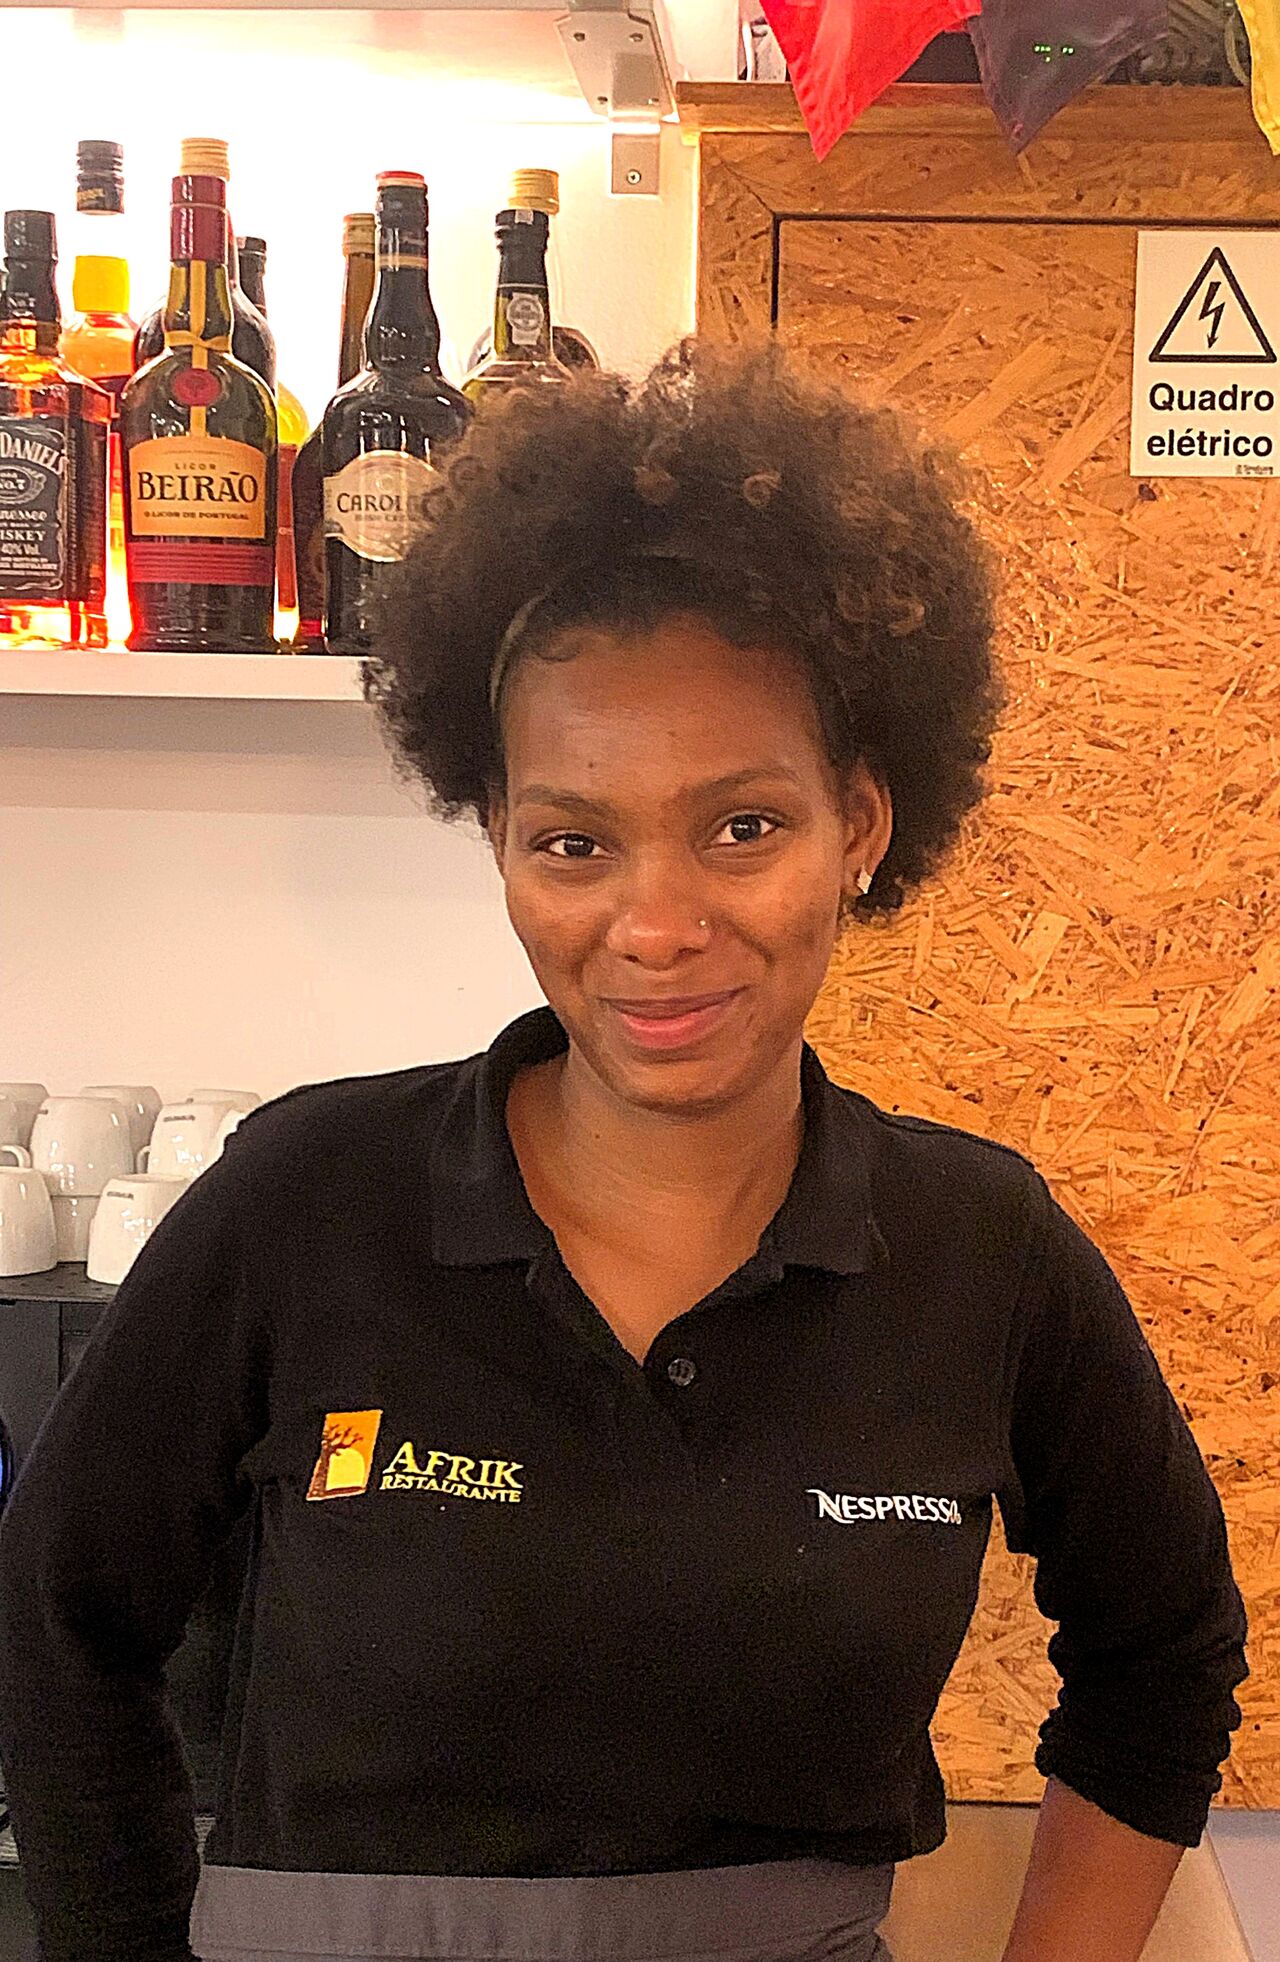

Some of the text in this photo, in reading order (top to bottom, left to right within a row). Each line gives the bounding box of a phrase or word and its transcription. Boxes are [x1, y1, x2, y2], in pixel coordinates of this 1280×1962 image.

[1149, 383, 1274, 411] Quadro
[1147, 428, 1272, 457] elétrico
[175, 463, 216, 471] LICOR
[137, 471, 258, 503] BEIRÃO
[0, 530, 46, 541] ISKEY
[382, 1441, 524, 1489] AFRIK
[379, 1474, 521, 1503] RESTAURANTE
